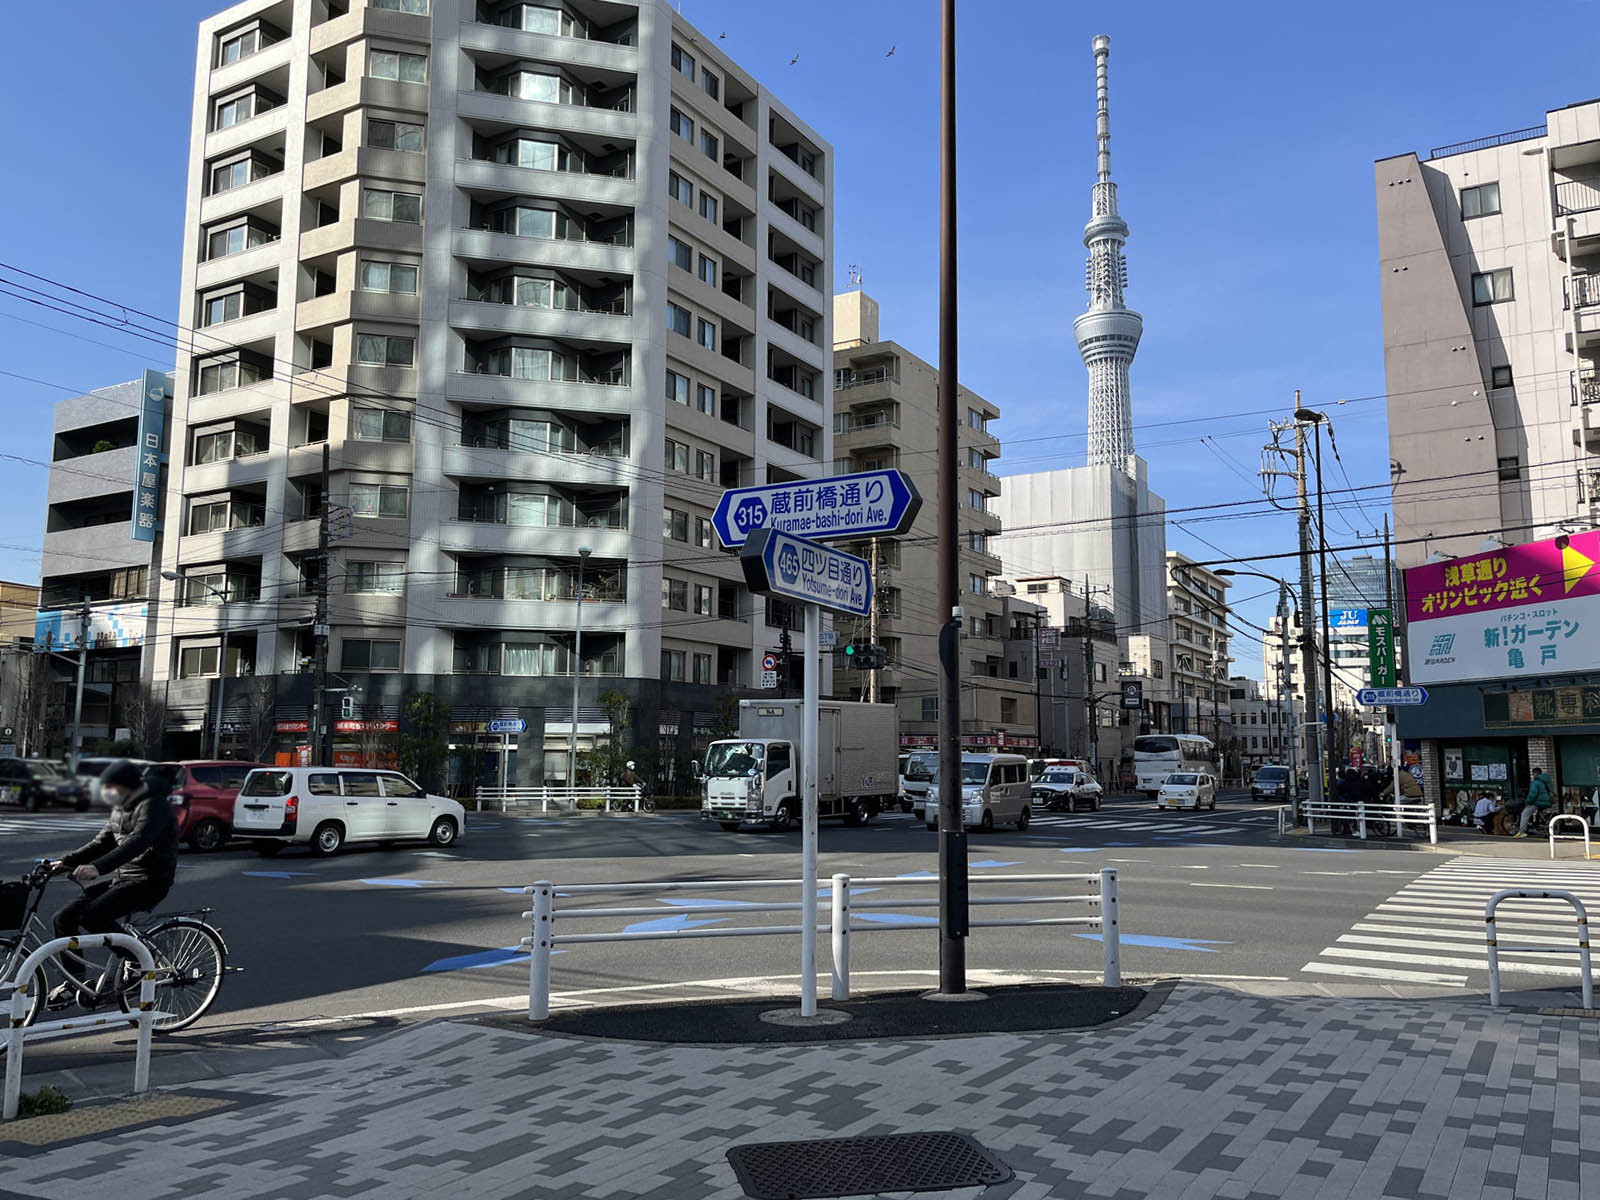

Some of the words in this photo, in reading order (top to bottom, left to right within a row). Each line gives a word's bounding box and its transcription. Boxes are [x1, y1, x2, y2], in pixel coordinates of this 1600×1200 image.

[138, 433, 159, 529] 日本屋楽器
[770, 480, 884, 515] 蔵前橋通り
[737, 505, 764, 527] 315
[866, 506, 887, 523] Ave.
[780, 552, 798, 577] 465
[802, 548, 863, 587] 四ツ目通り
[1444, 557, 1508, 588] 浅草通り
[802, 573, 848, 601] Yotsume-dori
[1421, 574, 1543, 613] オリンピック近く
[1375, 626, 1389, 684] モスバーガー
